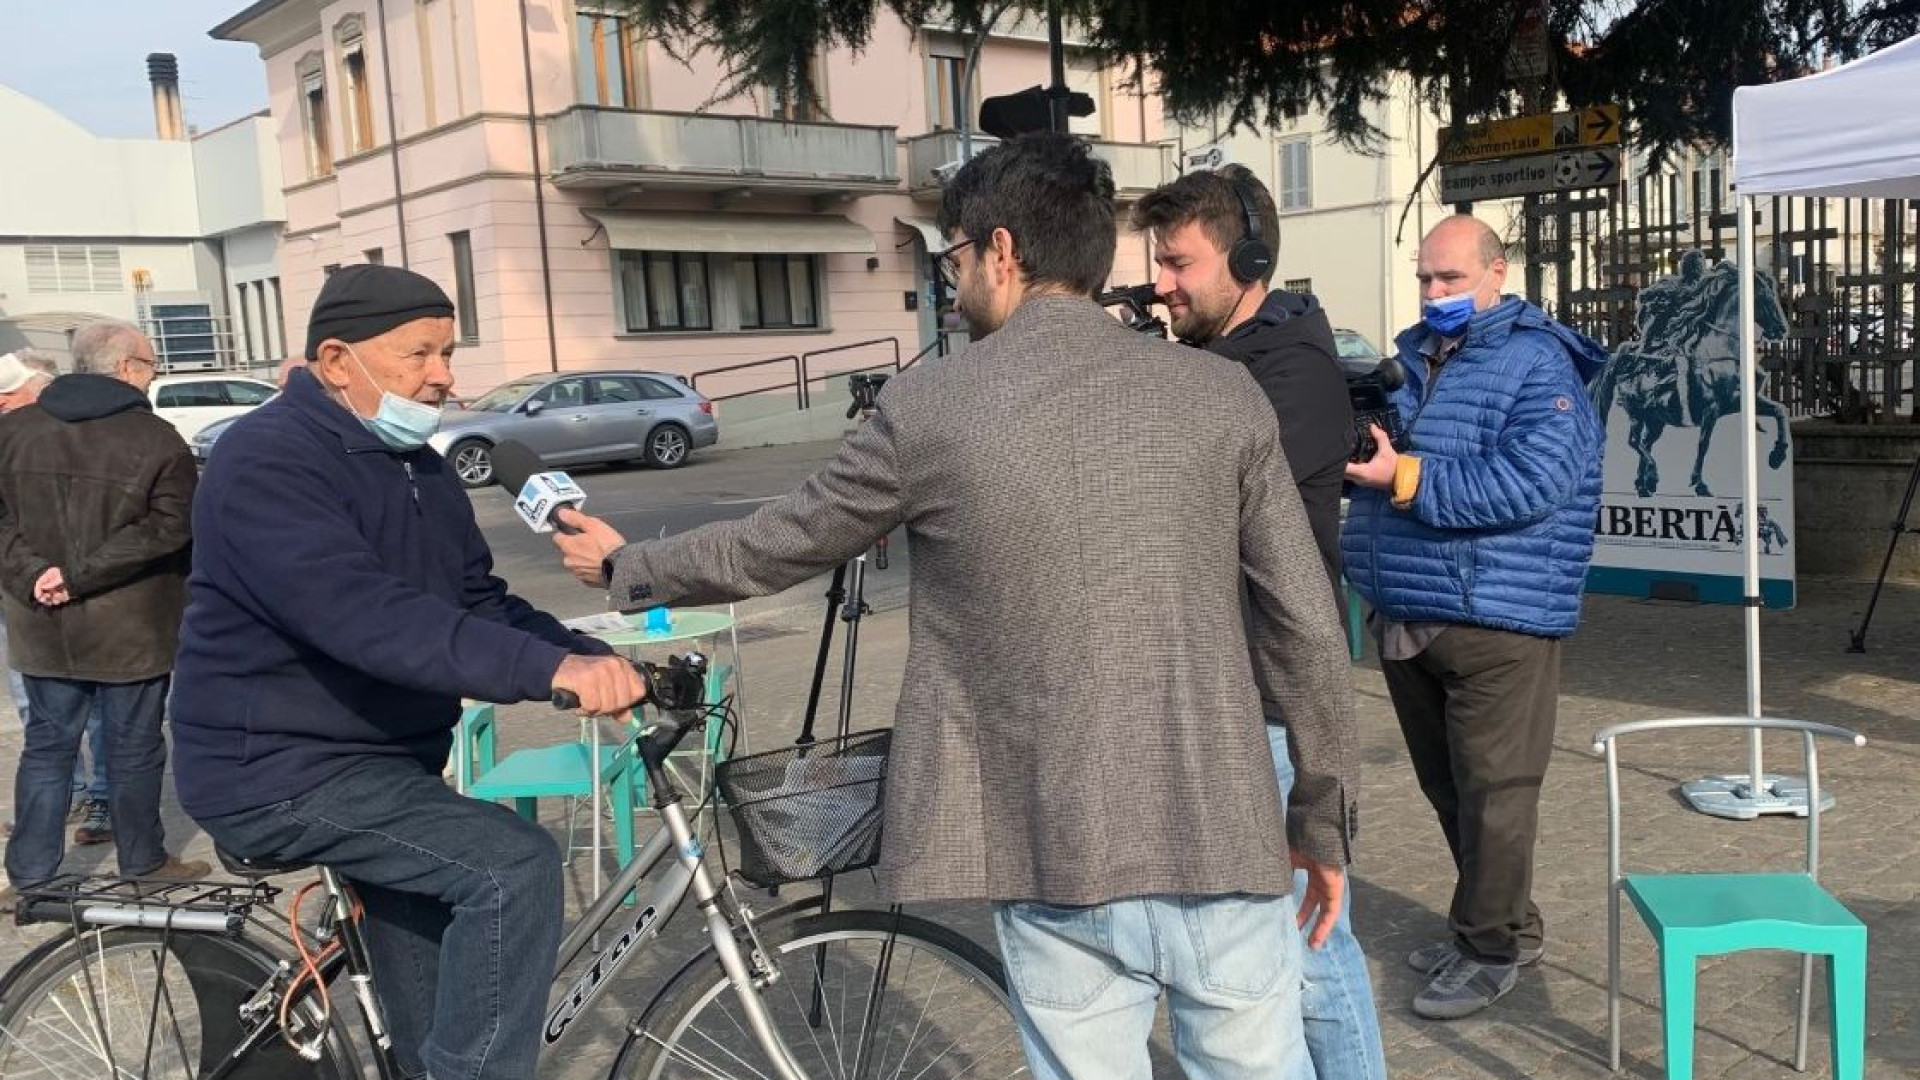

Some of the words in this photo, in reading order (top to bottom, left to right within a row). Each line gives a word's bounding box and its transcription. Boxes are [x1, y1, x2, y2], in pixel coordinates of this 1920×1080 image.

[1445, 174, 1486, 191] campo
[1490, 166, 1545, 187] sportivo
[1595, 505, 1736, 543] IBERTÀ
